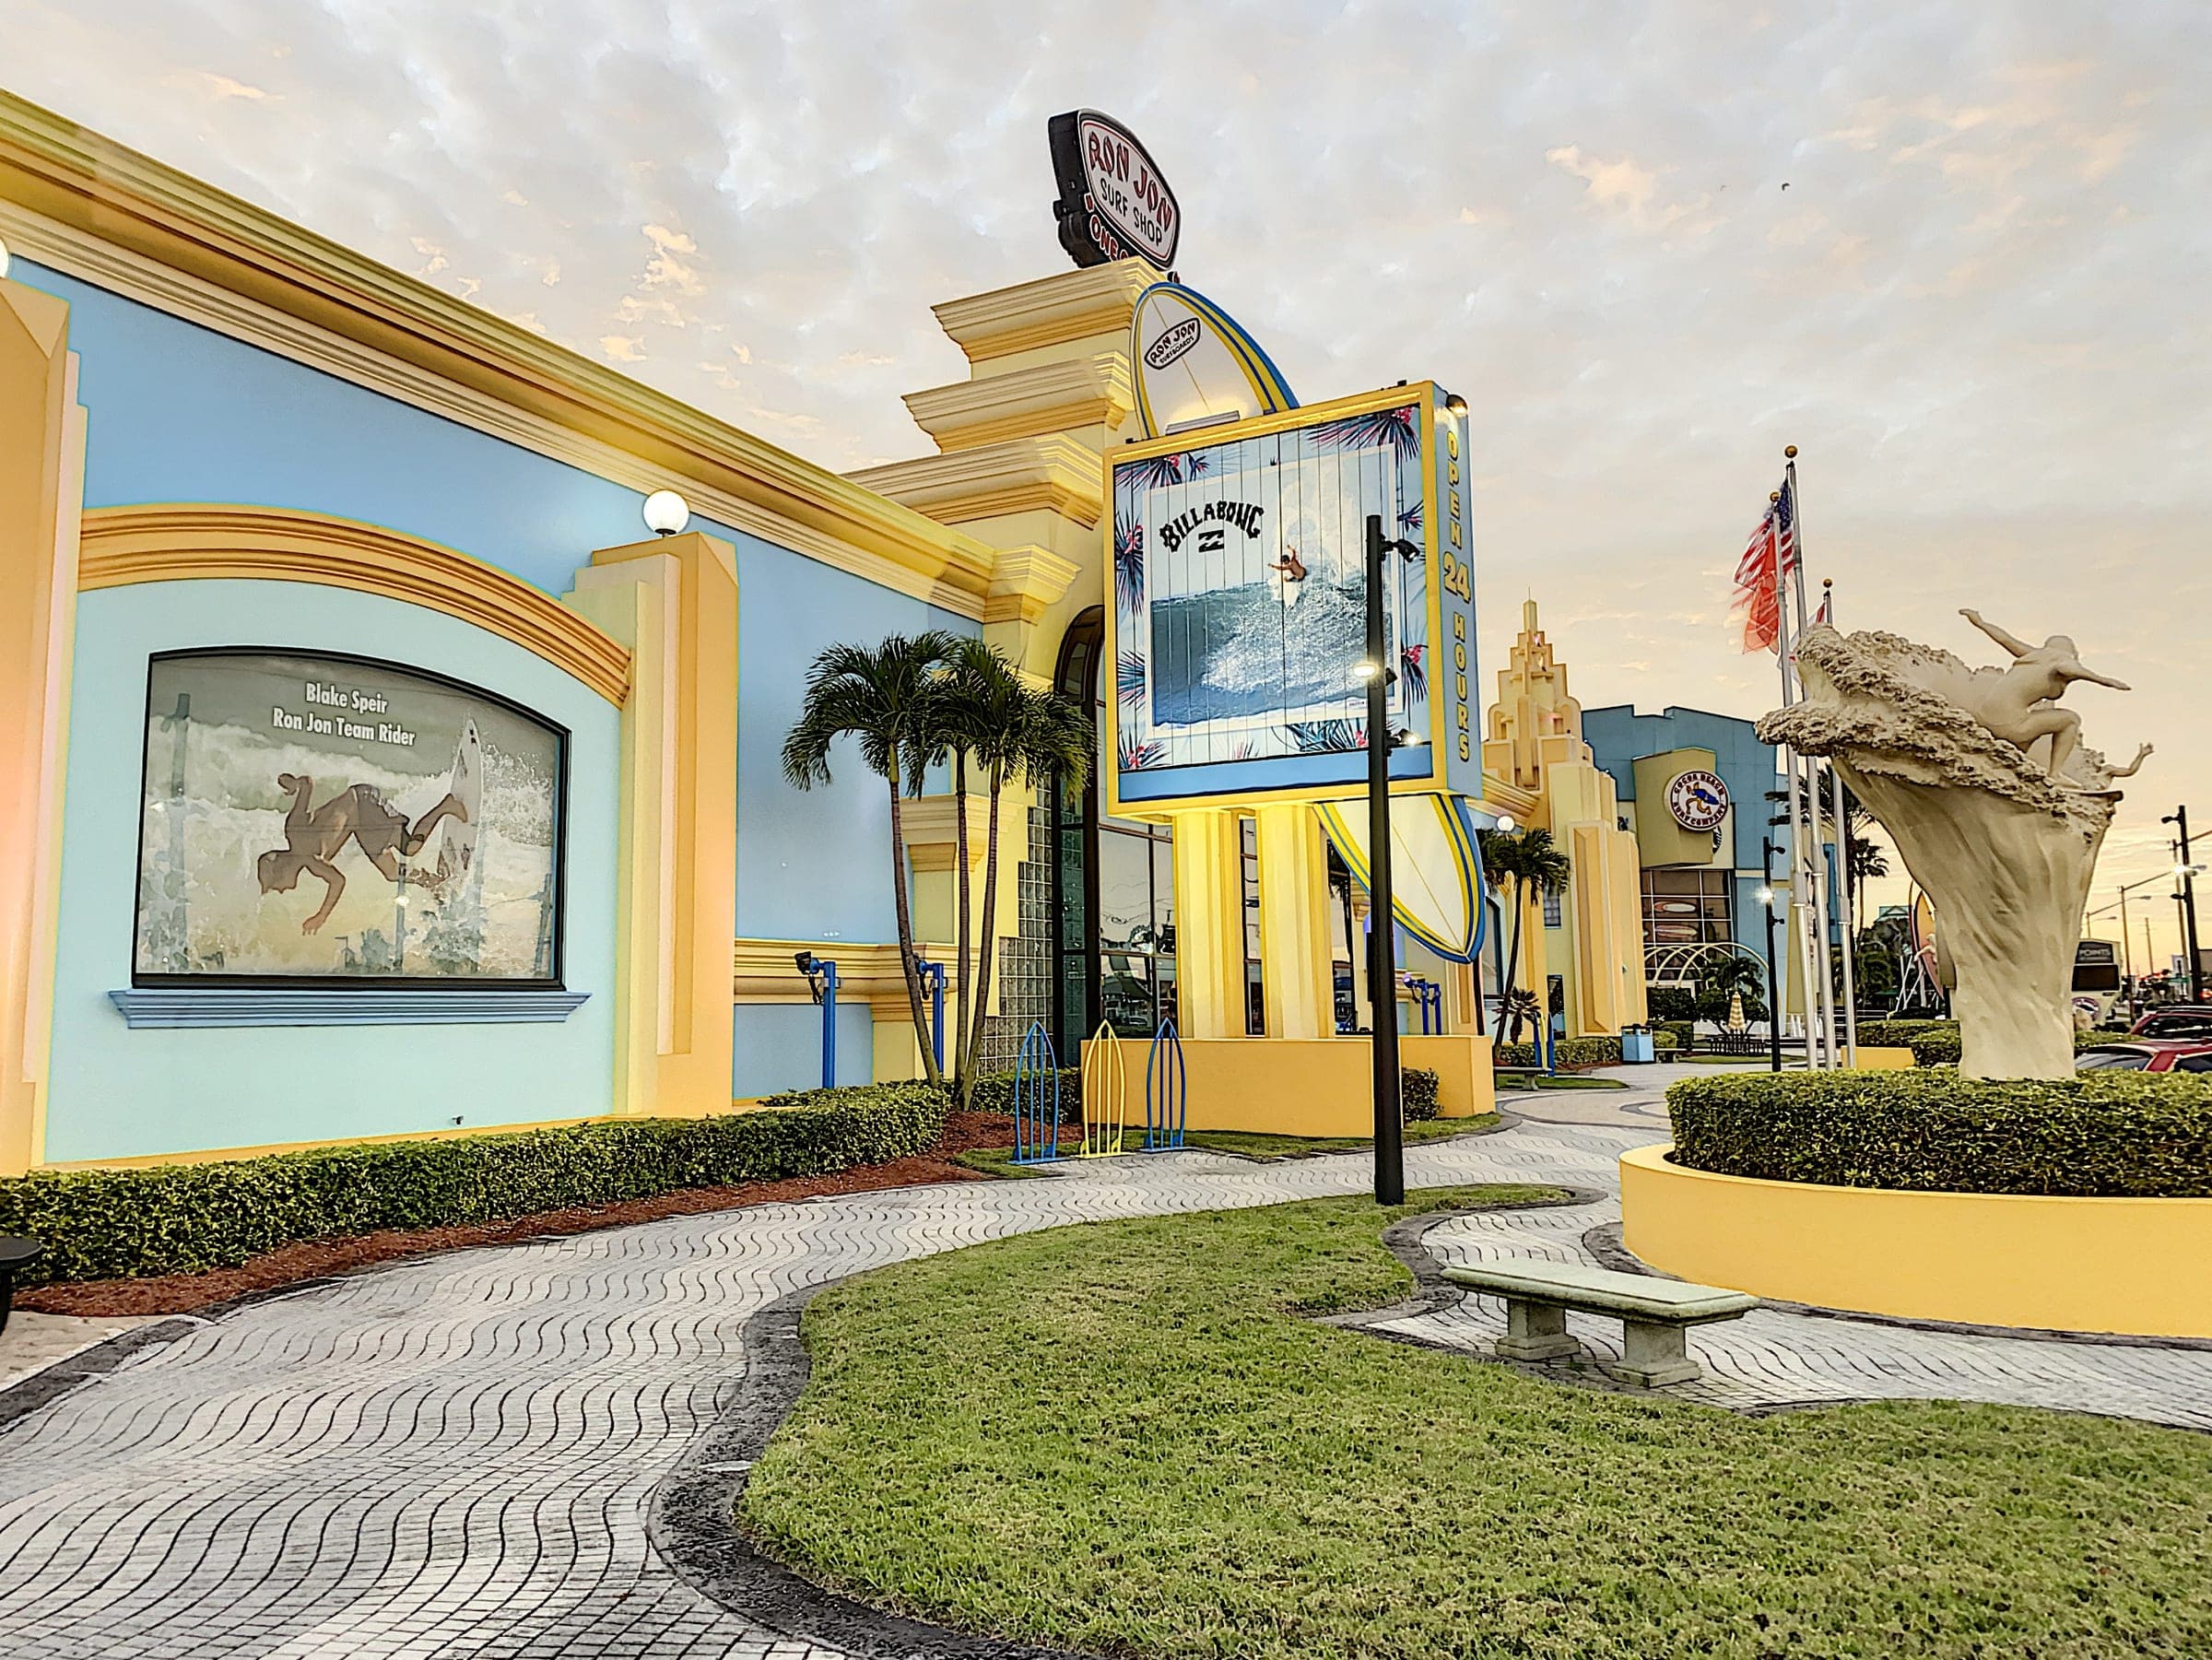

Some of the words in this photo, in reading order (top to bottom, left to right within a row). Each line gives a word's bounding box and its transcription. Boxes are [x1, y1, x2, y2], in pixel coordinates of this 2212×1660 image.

[1088, 131, 1129, 182] RON
[1134, 165, 1172, 232] JON
[1100, 178, 1128, 217] SURF
[1133, 206, 1163, 247] SHOP
[1149, 336, 1171, 363] RON
[1173, 323, 1195, 342] JON
[1447, 430, 1462, 549] OPEN
[1159, 500, 1265, 553] BILLABONG
[1443, 551, 1471, 604] 24
[305, 682, 348, 707] Blake
[351, 690, 388, 714] Speir
[1453, 612, 1469, 762] HOURS
[273, 707, 303, 731] Ron
[307, 712, 332, 735] Jon
[335, 717, 375, 741] Team
[378, 723, 416, 746] Rider
[1674, 773, 1698, 794] COCOA
[1700, 773, 1725, 795] BEACH
[1673, 802, 1690, 821] SURF
[1690, 803, 1726, 826] COMPANY
